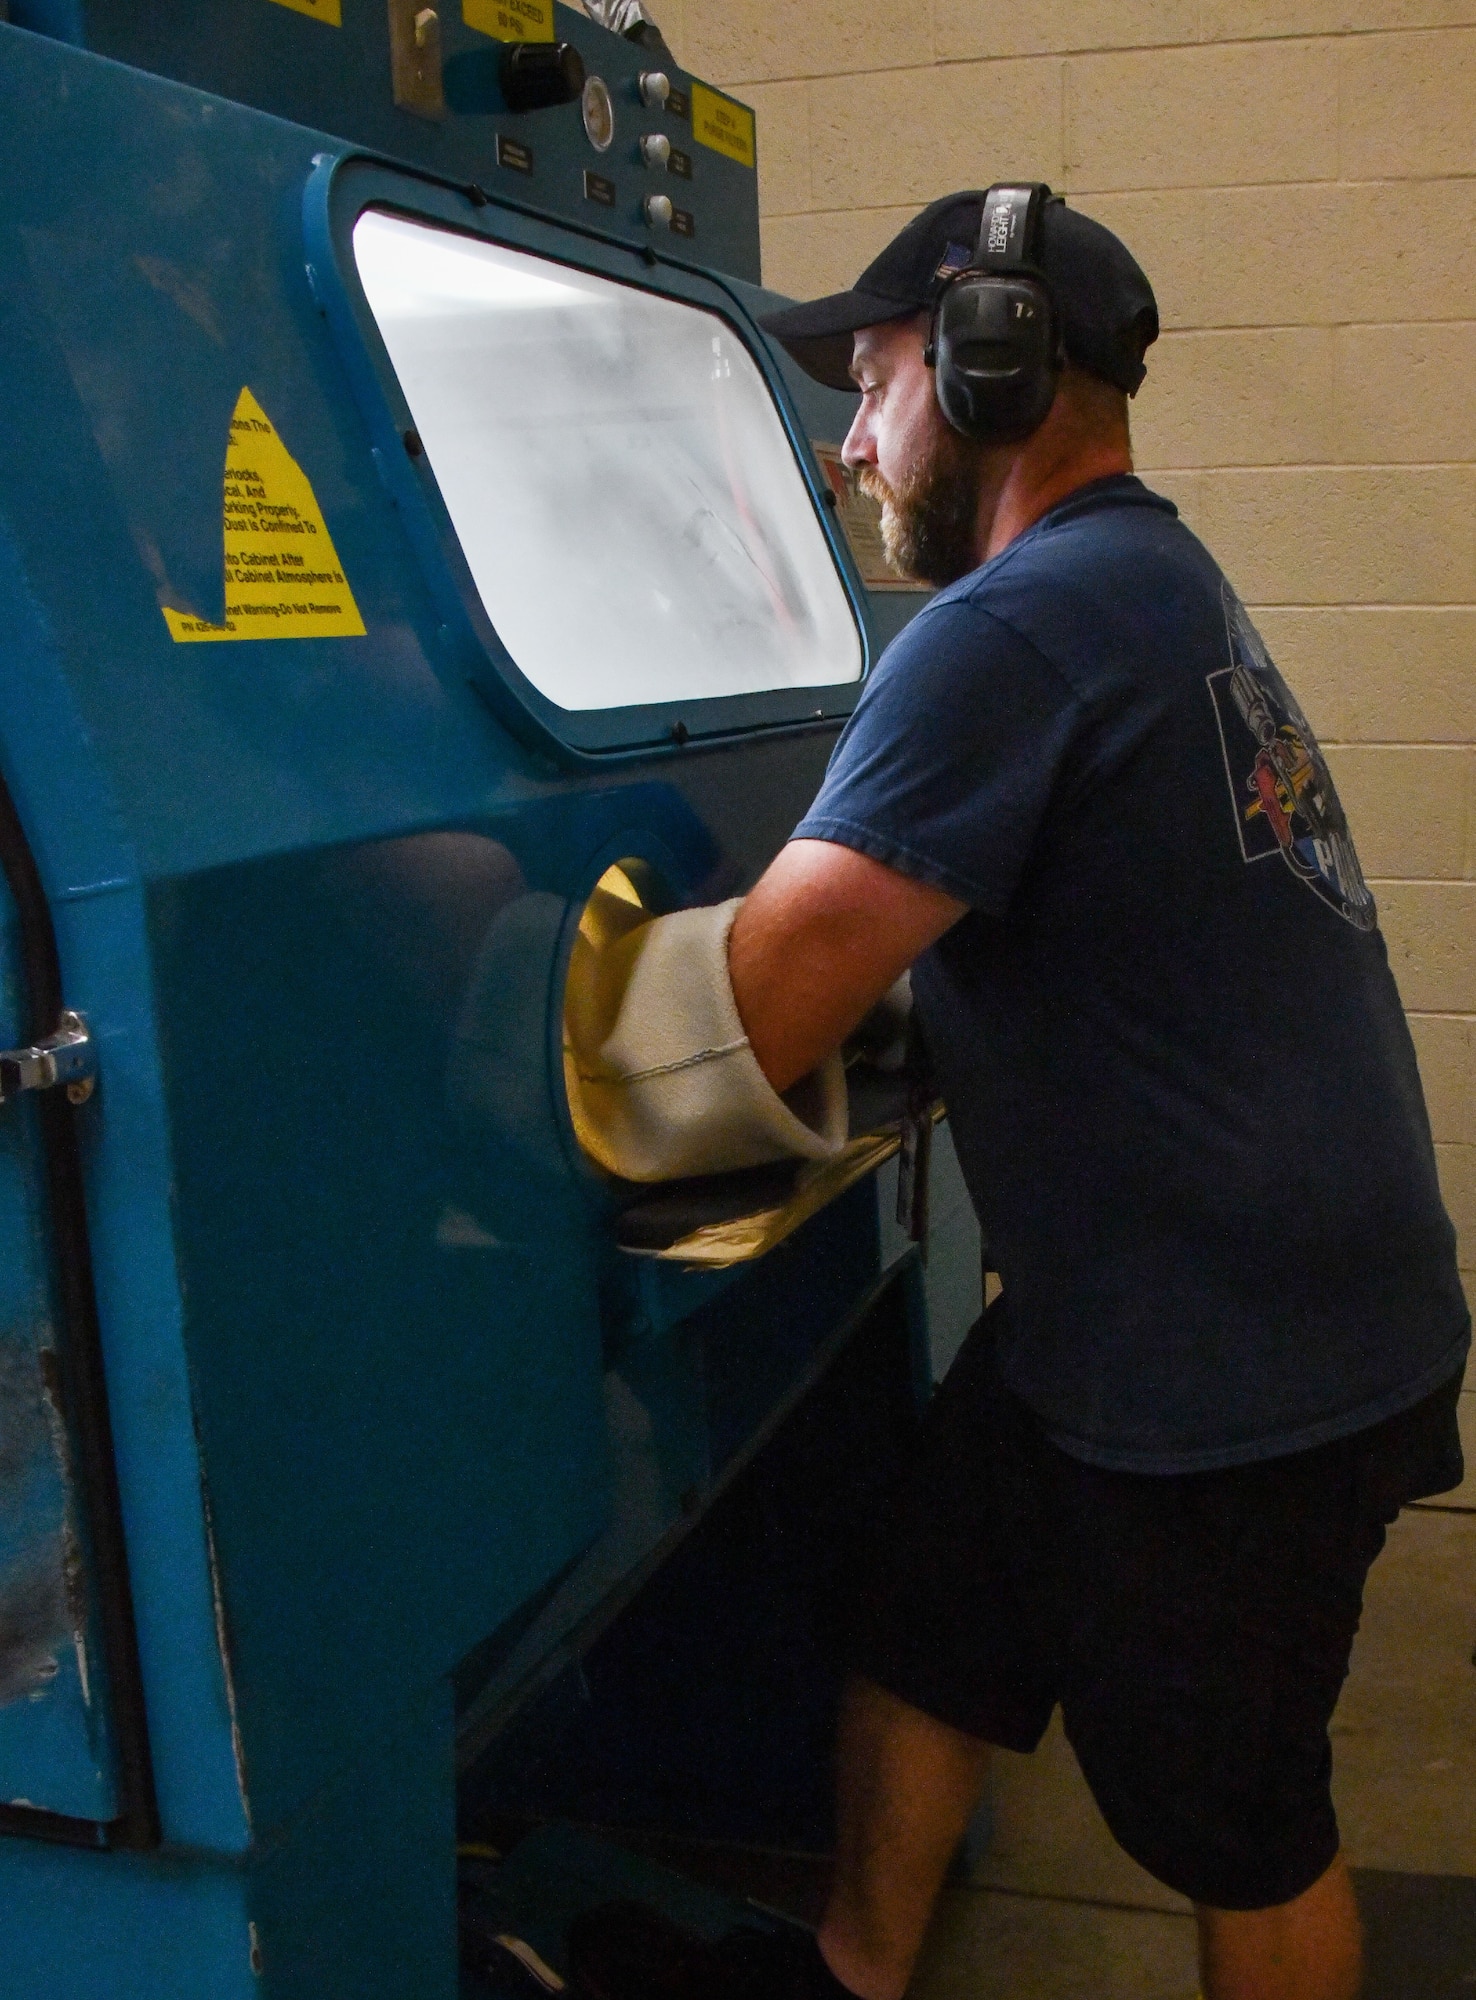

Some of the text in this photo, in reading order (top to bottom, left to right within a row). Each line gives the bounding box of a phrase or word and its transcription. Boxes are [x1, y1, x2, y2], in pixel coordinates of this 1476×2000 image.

[987, 215, 1000, 253] HOWARD
[995, 216, 1010, 253] LEIGHT
[250, 418, 271, 433] The
[245, 484, 266, 499] And
[224, 517, 249, 533] Dust
[260, 518, 305, 534] Confined
[303, 520, 317, 534] To
[240, 551, 280, 567] Cabinet
[281, 553, 304, 567] After
[235, 569, 275, 583] Cabinet
[276, 568, 333, 586] Atmosphere
[292, 603, 309, 615] Not
[308, 603, 342, 614] Remove
